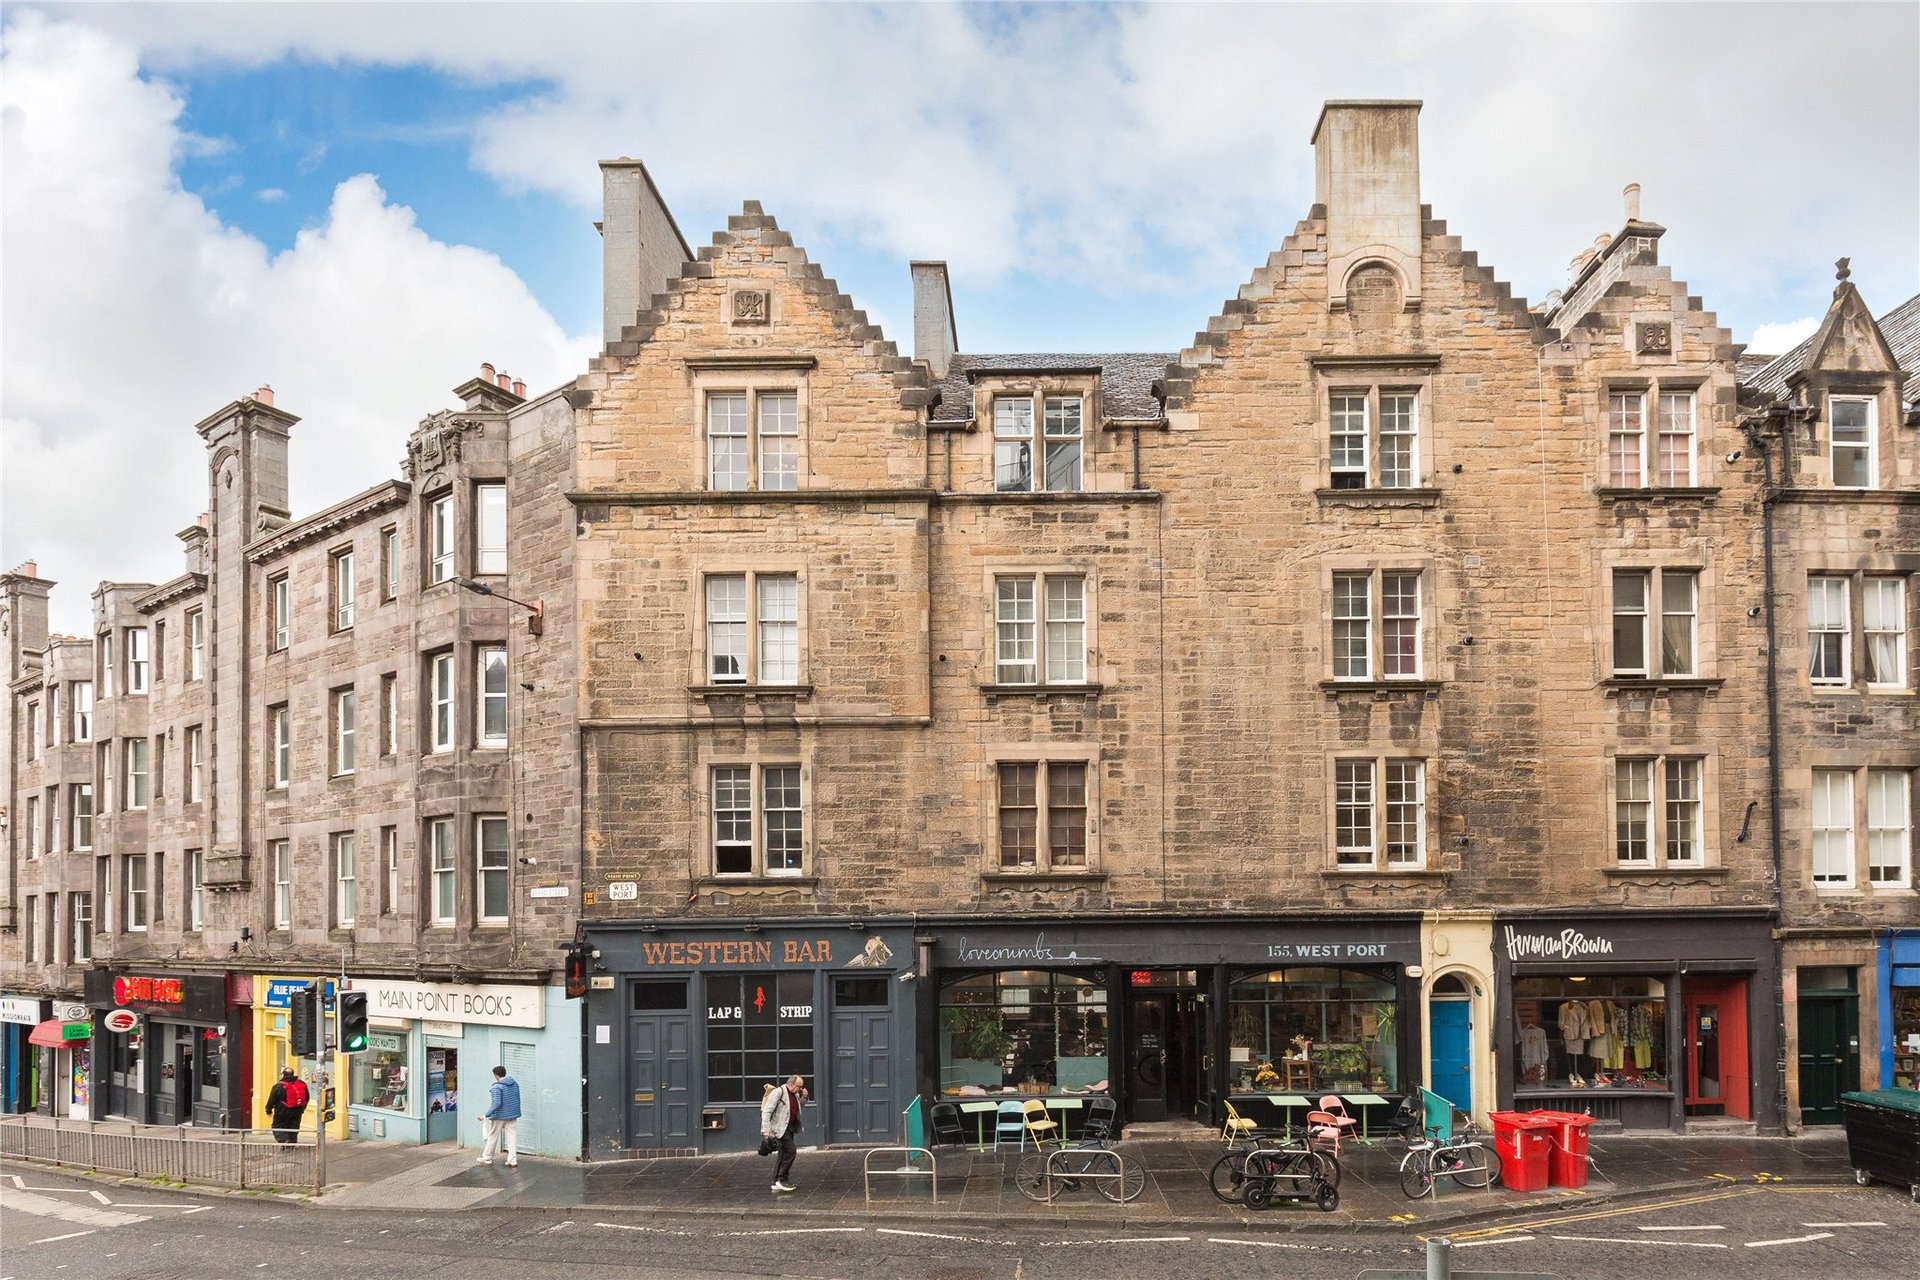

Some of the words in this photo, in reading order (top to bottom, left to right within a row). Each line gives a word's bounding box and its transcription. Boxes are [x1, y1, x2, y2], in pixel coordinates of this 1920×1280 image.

[642, 941, 771, 965] WESTERN
[783, 939, 833, 963] BAR
[958, 931, 1053, 961] lovecrumbs
[1295, 944, 1341, 957] WEST
[1347, 944, 1387, 957] PORT
[273, 984, 289, 995] BLUE
[379, 989, 412, 1010] MAIN
[416, 991, 458, 1013] POINT
[464, 994, 512, 1016] BOOKS
[708, 1007, 732, 1019] LAP
[733, 1006, 742, 1018] &
[780, 1005, 813, 1018] STRIP
[381, 1038, 396, 1049] WANTED
